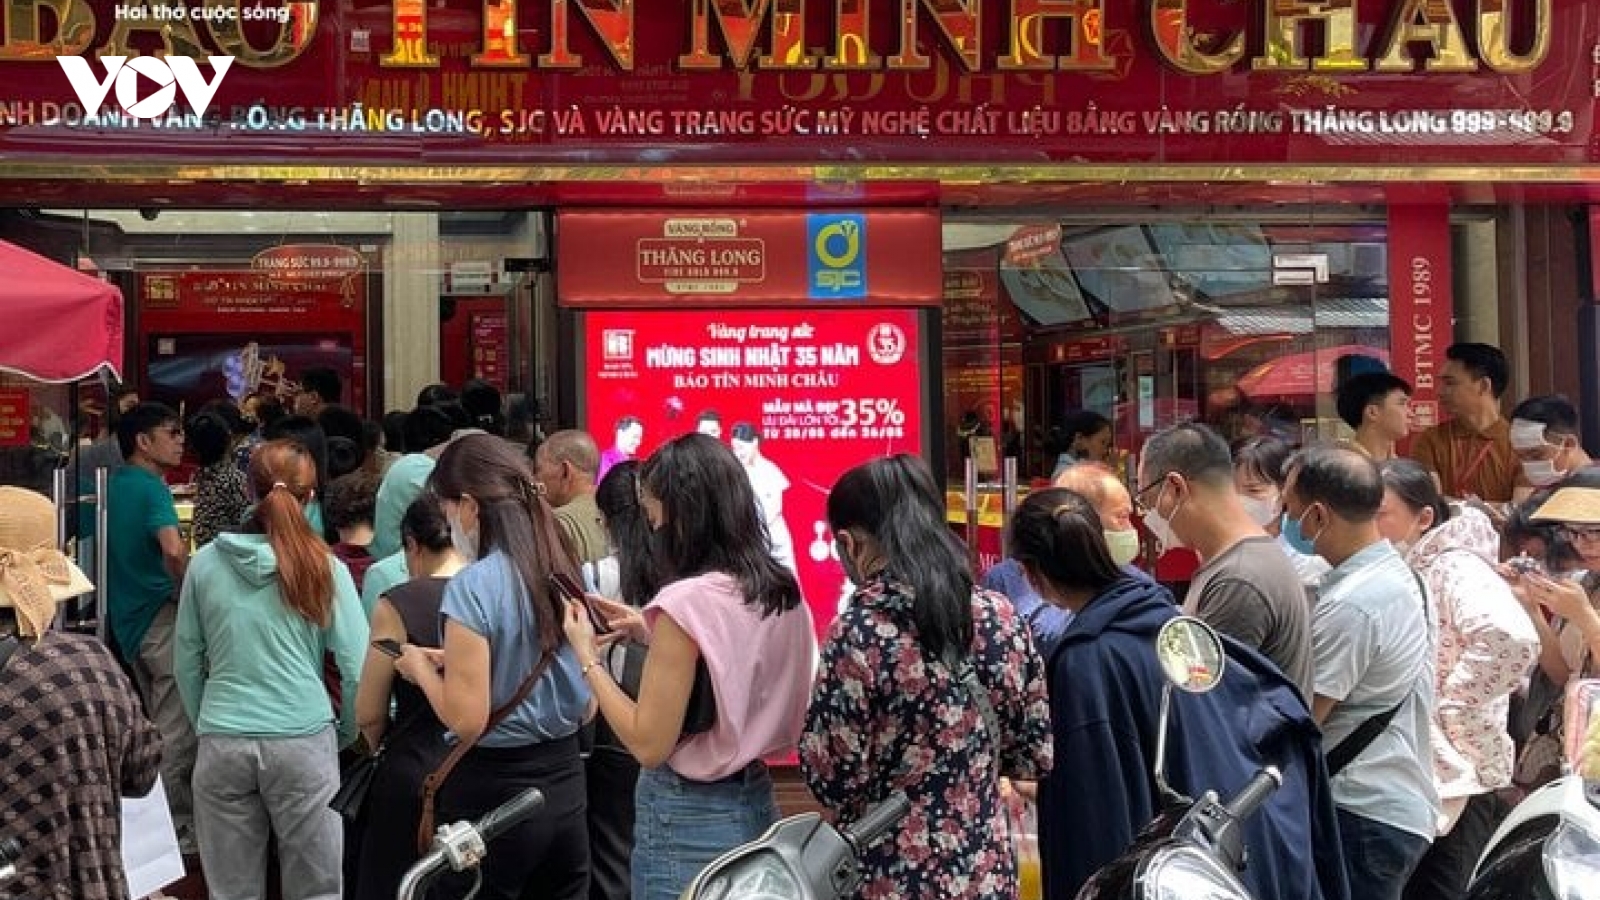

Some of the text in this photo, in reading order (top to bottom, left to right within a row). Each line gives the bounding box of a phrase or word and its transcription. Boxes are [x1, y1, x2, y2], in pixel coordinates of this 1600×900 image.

[318, 103, 404, 132] THĂNG
[412, 109, 492, 137] LONG,
[500, 110, 545, 134] SJC
[553, 105, 585, 134] VÀ
[596, 105, 664, 134] VÀNG
[671, 111, 754, 134] TRANG
[761, 104, 809, 134] SỨC
[817, 106, 853, 134] MỸ
[862, 106, 929, 139] NGHỆ
[936, 103, 1001, 134] CHẤT
[1008, 104, 1060, 138] LIỆU
[1142, 105, 1209, 134] VÀNG
[1290, 105, 1375, 133] THĂNG
[1380, 109, 1447, 132] LONG
[640, 246, 761, 266] THĂNG LONG
[1412, 257, 1434, 388] BTMC 1989
[699, 346, 741, 368] SINH
[795, 346, 818, 367] 35
[744, 373, 788, 388] MINH
[840, 397, 905, 427] 35%
